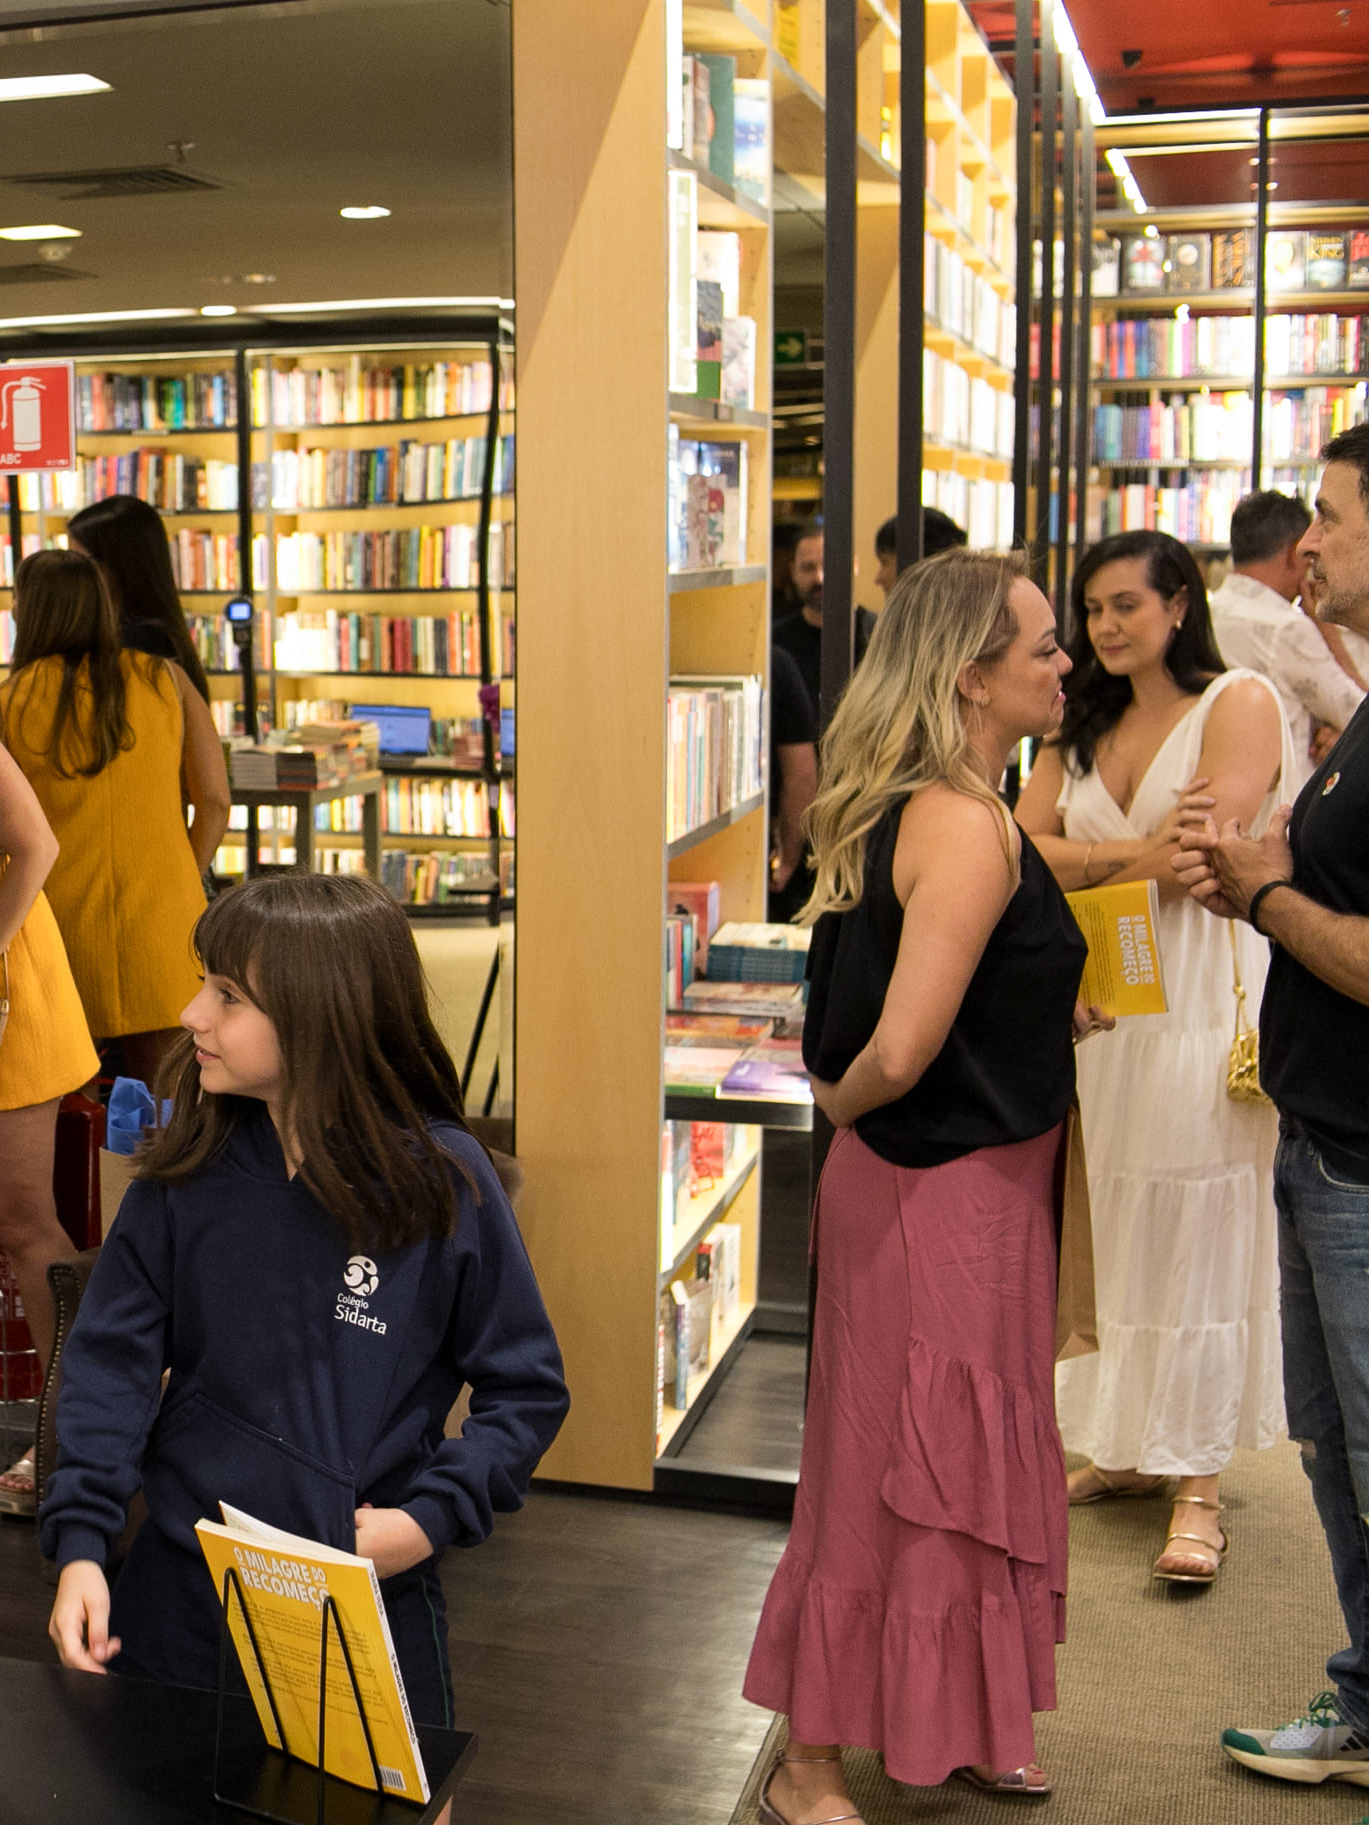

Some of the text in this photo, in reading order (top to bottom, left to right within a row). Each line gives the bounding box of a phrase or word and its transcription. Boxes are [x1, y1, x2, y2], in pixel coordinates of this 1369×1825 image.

[0, 453, 22, 464] ABC
[1117, 915, 1139, 985] RECOMEÇO
[1134, 924, 1152, 972] MILAGRE
[337, 1292, 369, 1309] Colégio
[334, 1304, 387, 1335] Sidarta
[233, 1546, 327, 1584] O MILAGRE DO
